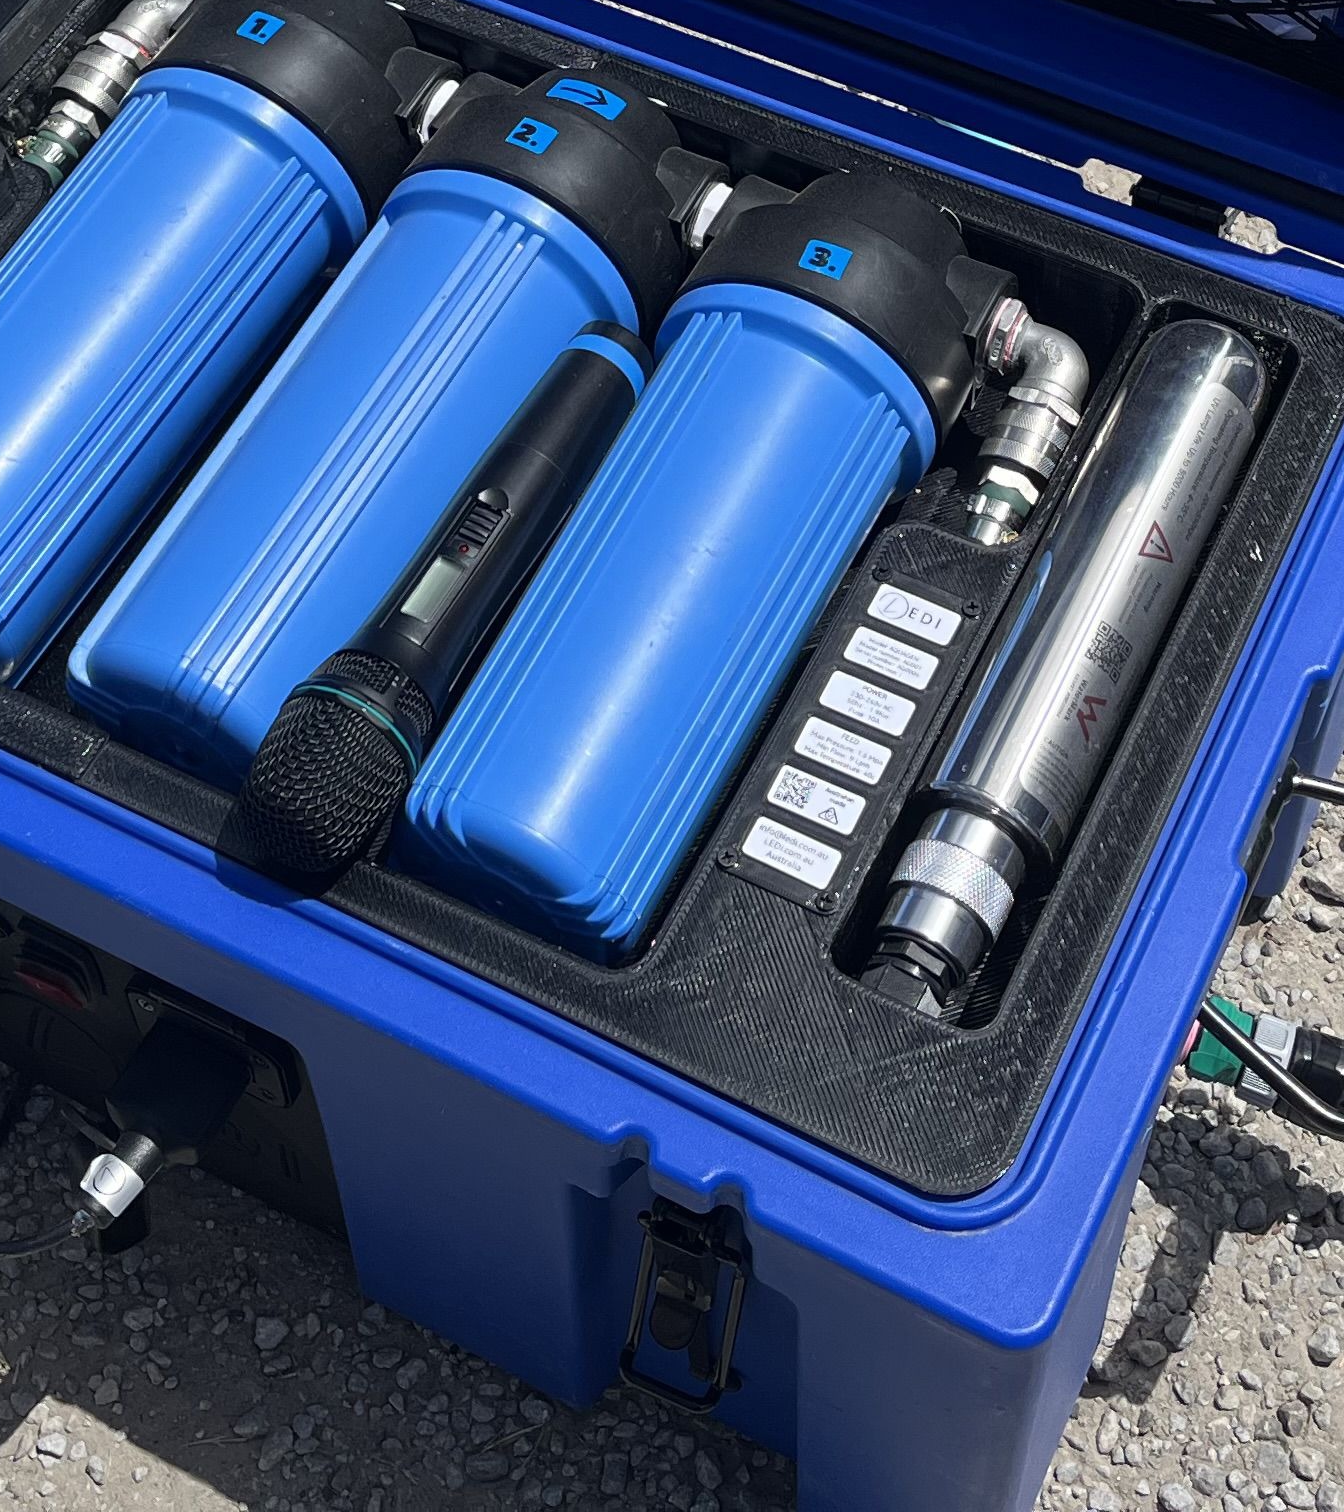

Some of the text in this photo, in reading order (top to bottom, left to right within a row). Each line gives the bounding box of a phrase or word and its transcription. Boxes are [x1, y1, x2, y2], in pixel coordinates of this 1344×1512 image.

[249, 16, 269, 38] 1.
[515, 118, 538, 147] 2.
[811, 244, 835, 272] 3.
[1210, 407, 1235, 446] Operating
[860, 684, 888, 700] POWER
[840, 732, 861, 746] FEED
[766, 849, 803, 873] Australia
